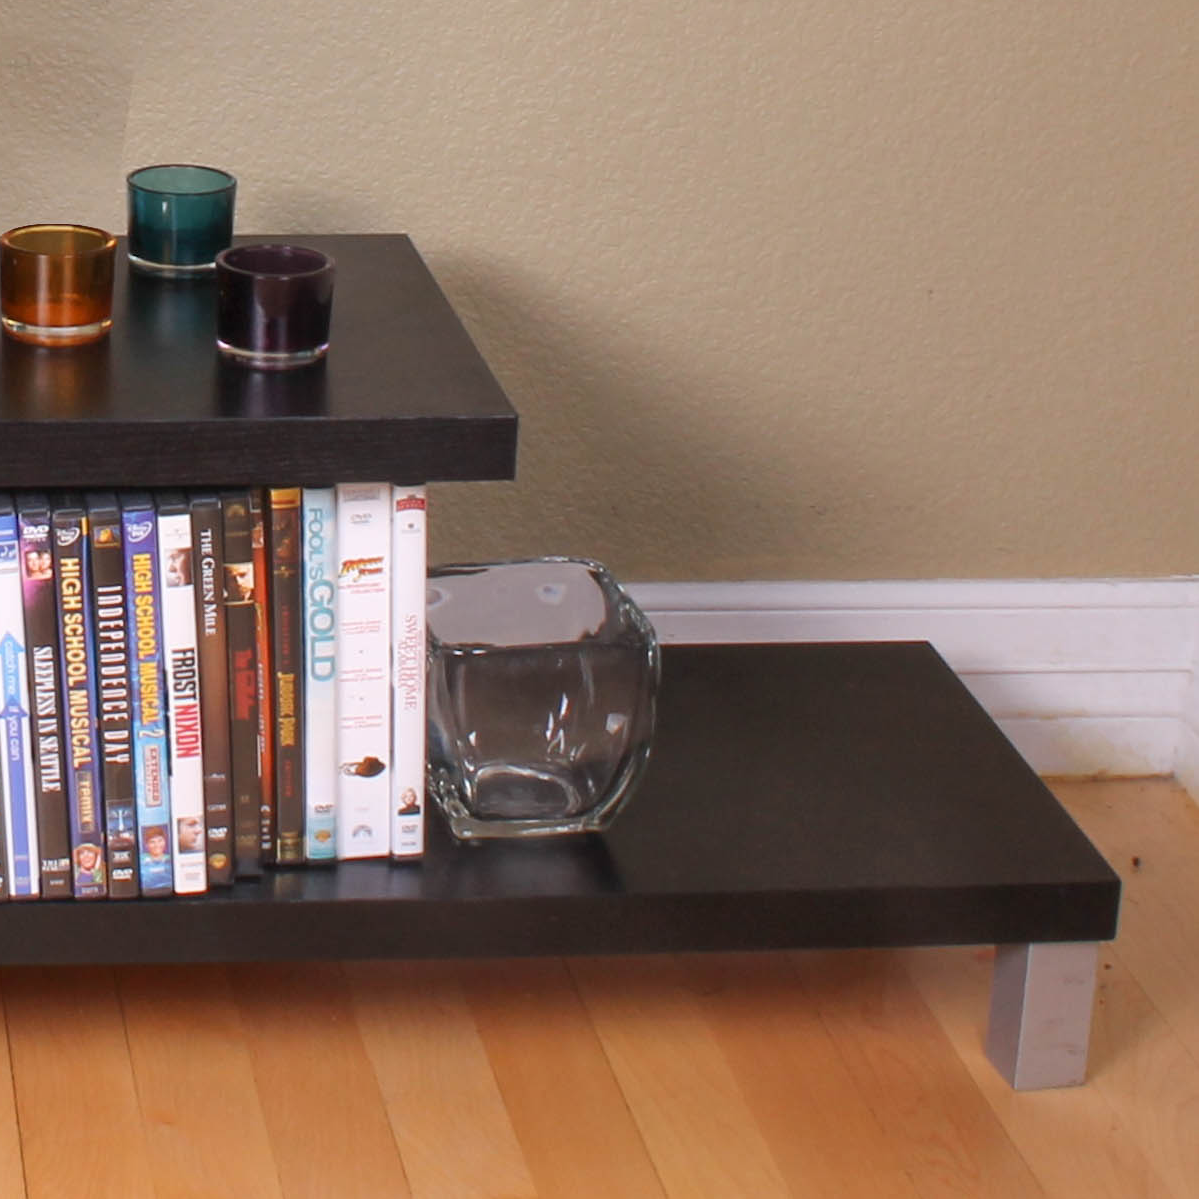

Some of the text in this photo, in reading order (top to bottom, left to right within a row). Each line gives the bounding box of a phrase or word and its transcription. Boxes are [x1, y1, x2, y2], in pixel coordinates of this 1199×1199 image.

[200, 529, 212, 554] THE
[201, 558, 216, 601] GREEN
[308, 508, 336, 682] FOOL'S GOLD
[60, 558, 92, 767] HIGH SCHOOL MUSICAL
[97, 586, 130, 764] INDEPENDENCE DAY
[133, 554, 164, 739] HIGH SCHOOL MUSICAL 2
[34, 647, 56, 715] SLEEPLESS
[171, 648, 201, 758] FROST NIXON
[9, 716, 19, 738] you
[10, 741, 20, 761] can
[39, 736, 61, 792] SEATTLE
